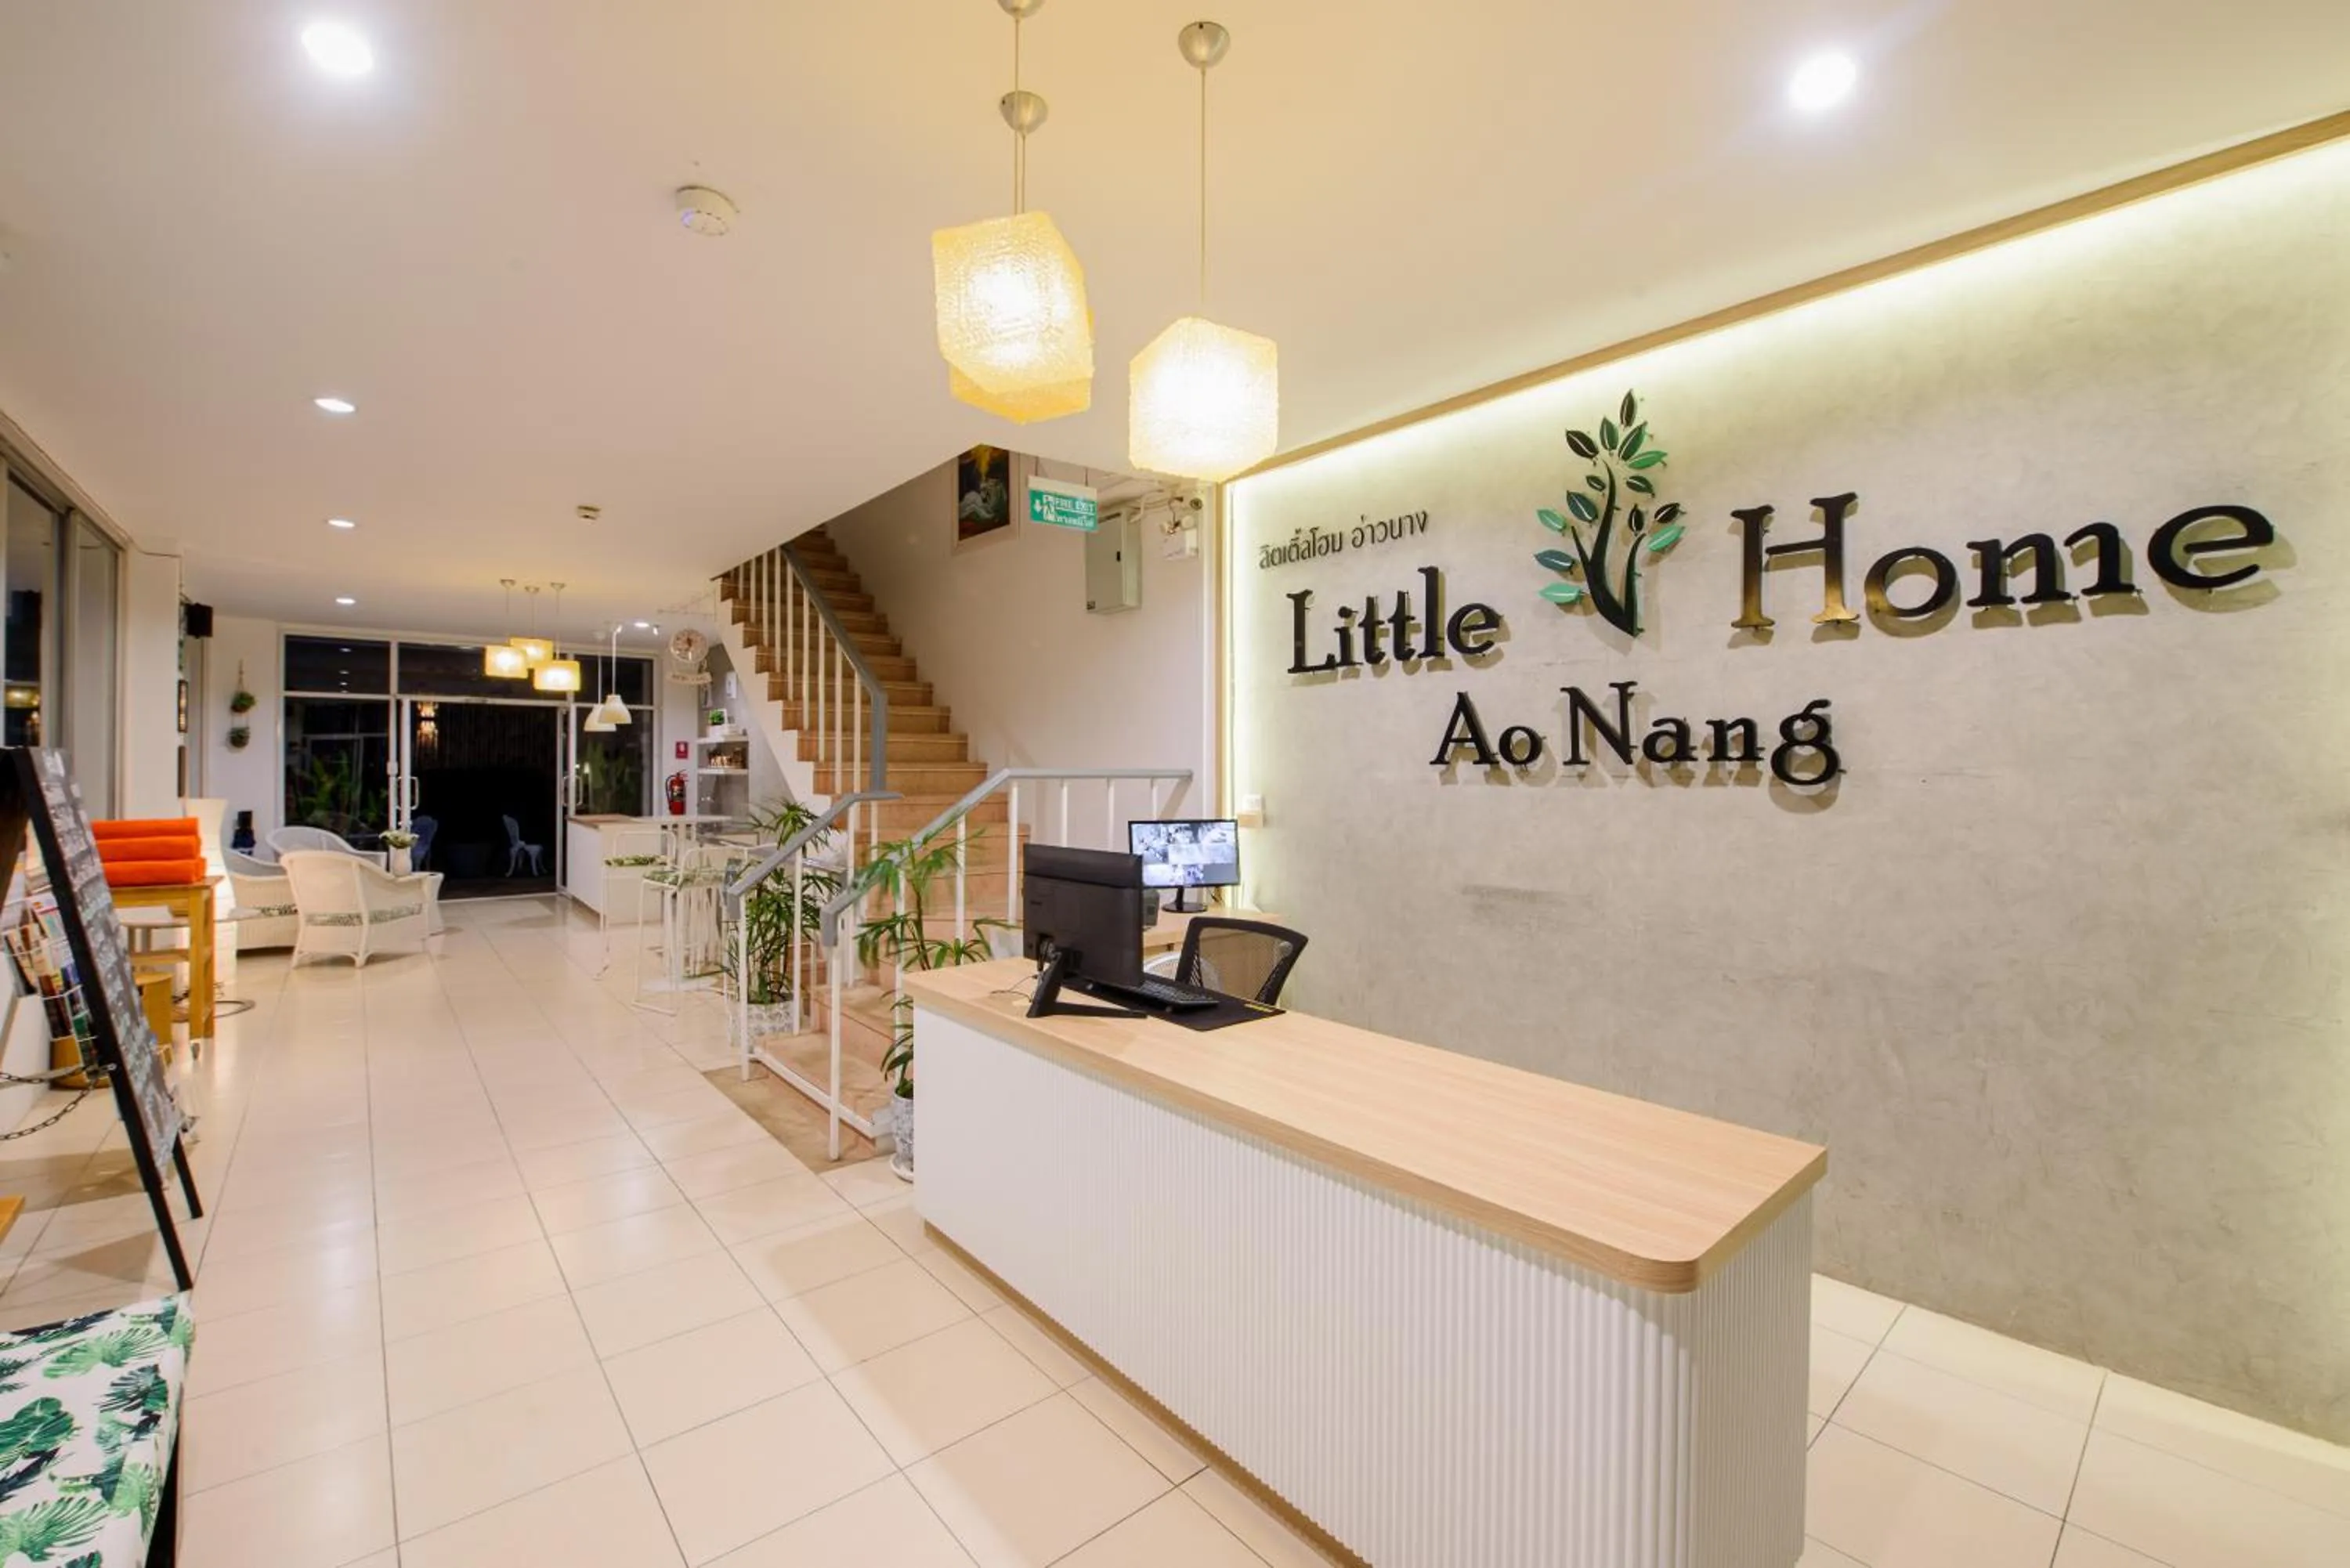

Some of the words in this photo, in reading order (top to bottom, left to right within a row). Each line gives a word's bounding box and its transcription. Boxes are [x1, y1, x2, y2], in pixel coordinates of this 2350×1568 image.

[1351, 510, 1428, 548] อ่าวนาง
[1286, 565, 1503, 674] Little
[1730, 491, 2276, 629] Home
[1430, 691, 1545, 767] Ao
[1560, 681, 1842, 786] Nang
